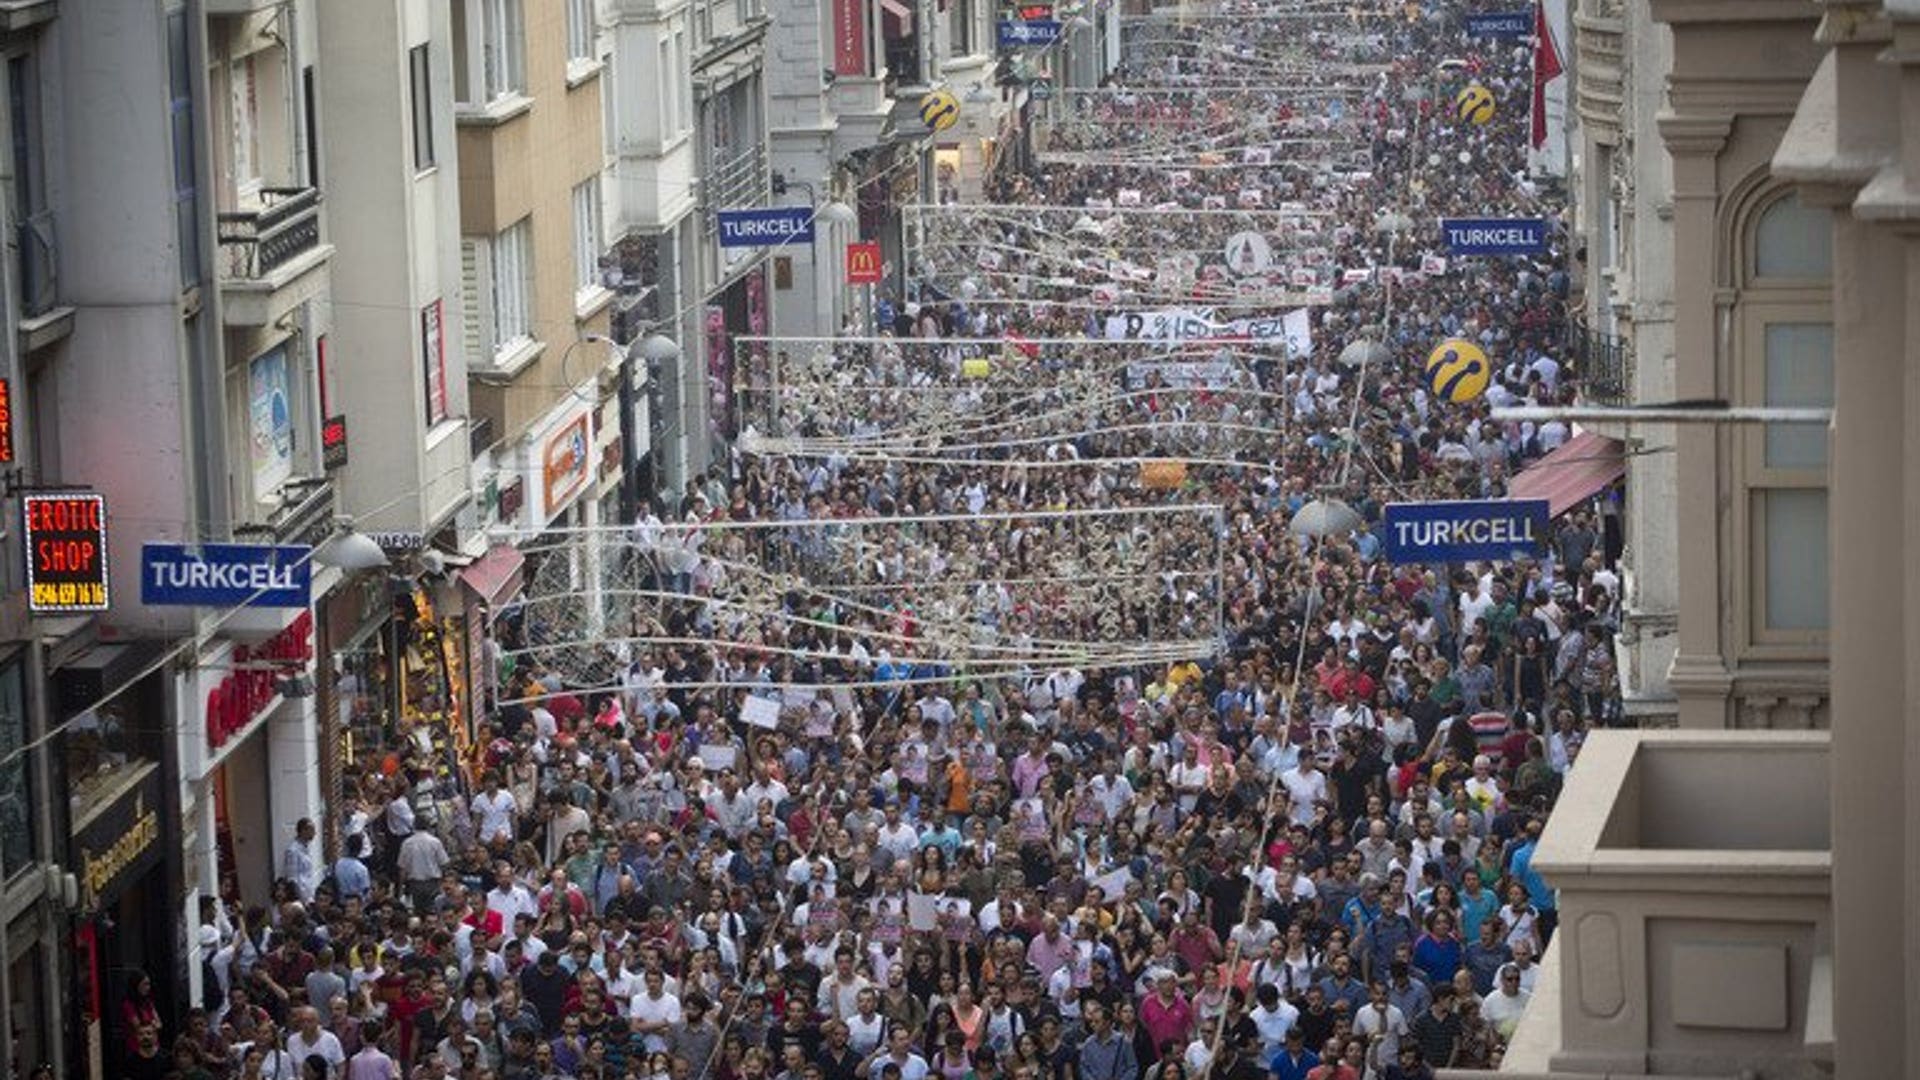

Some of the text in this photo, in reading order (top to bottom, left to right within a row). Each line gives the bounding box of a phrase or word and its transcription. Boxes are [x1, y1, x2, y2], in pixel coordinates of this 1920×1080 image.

[723, 219, 808, 237] TURKCELL
[1449, 229, 1538, 245] TURKCELL
[30, 502, 101, 532] EROTIC
[1395, 517, 1536, 546] TURKCELL
[39, 541, 95, 572] SHOP
[152, 562, 301, 588] TURKCELL
